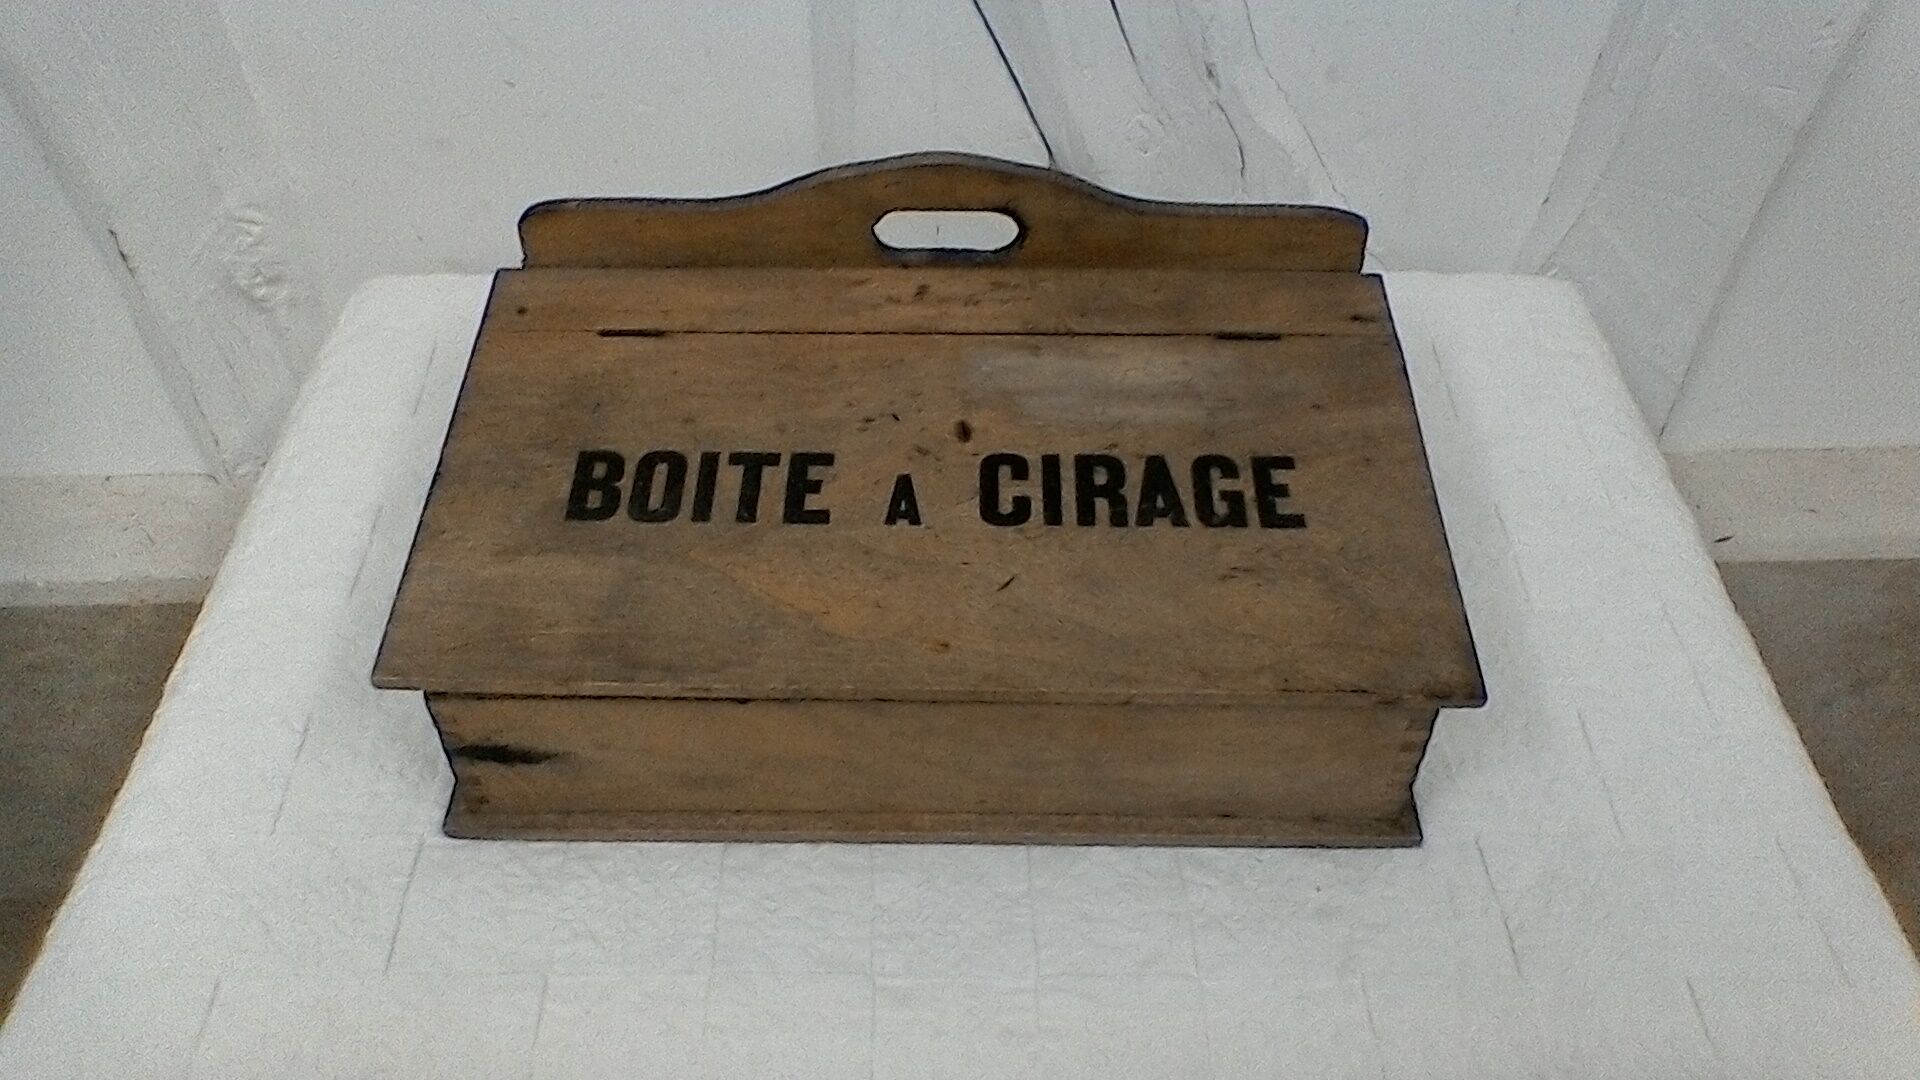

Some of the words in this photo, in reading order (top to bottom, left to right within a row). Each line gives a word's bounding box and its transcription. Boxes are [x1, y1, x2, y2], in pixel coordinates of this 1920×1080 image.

[565, 449, 835, 525] BOITE
[884, 473, 922, 526] A
[978, 452, 1307, 529] CIRAGE
